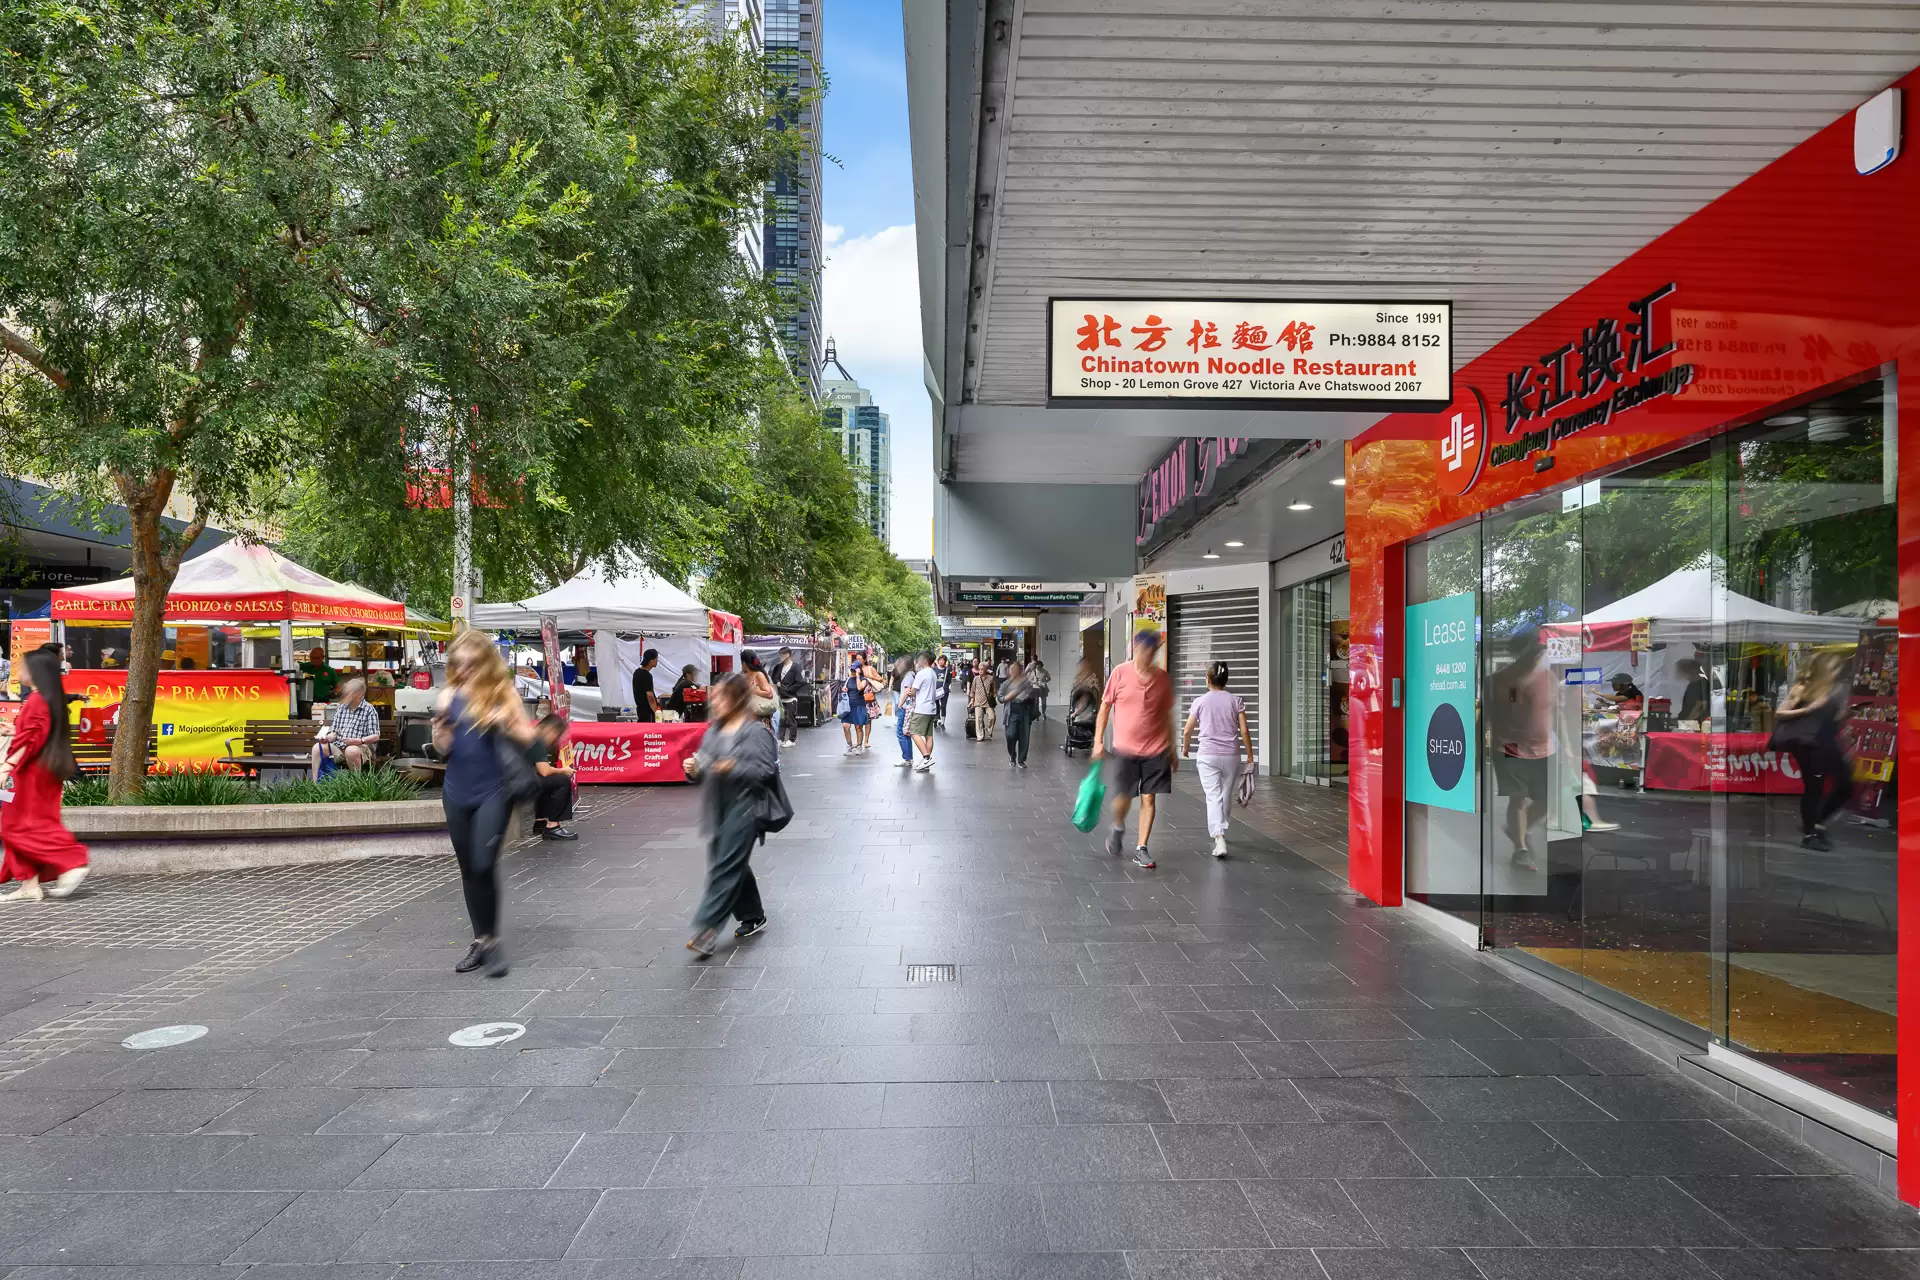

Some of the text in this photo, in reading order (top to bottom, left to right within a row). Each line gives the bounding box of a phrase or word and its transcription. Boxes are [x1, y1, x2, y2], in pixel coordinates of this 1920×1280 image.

[1376, 313, 1442, 323] Since 1991
[1076, 314, 1316, 354] 北方拉麵館
[1329, 333, 1440, 347] Ph:9884 8152
[1501, 283, 1677, 434] 长江换汇
[1081, 356, 1417, 376] Chinatown Noodle Restaurant
[1080, 377, 1112, 390] Shop
[1122, 378, 1136, 389] 20
[1140, 378, 1180, 390] Lemon
[1183, 380, 1219, 390] Grove
[1222, 380, 1243, 390] 427
[1249, 380, 1295, 391] Victoria
[1299, 381, 1321, 391] Ave
[1324, 381, 1391, 392] Chatswood
[1394, 382, 1422, 392] 2067
[1490, 427, 1550, 467] Changjiang
[32, 570, 73, 581] Fiore
[1021, 582, 1043, 590] Pearl
[55, 600, 101, 612] GARLIC
[224, 601, 232, 611] &
[235, 601, 283, 612] SALSAS
[292, 602, 320, 614] GARLIC
[350, 607, 378, 619] CHORIZO
[383, 610, 404, 621] SALSAS
[1424, 618, 1466, 647] Lease
[780, 636, 810, 644] French
[998, 640, 1015, 649] 445
[1436, 661, 1467, 675] 8448 1200
[1430, 679, 1467, 691] shead.com.au
[171, 685, 261, 701] PRAWNS
[1429, 739, 1463, 755] SHEAD
[599, 765, 624, 773] Catering
